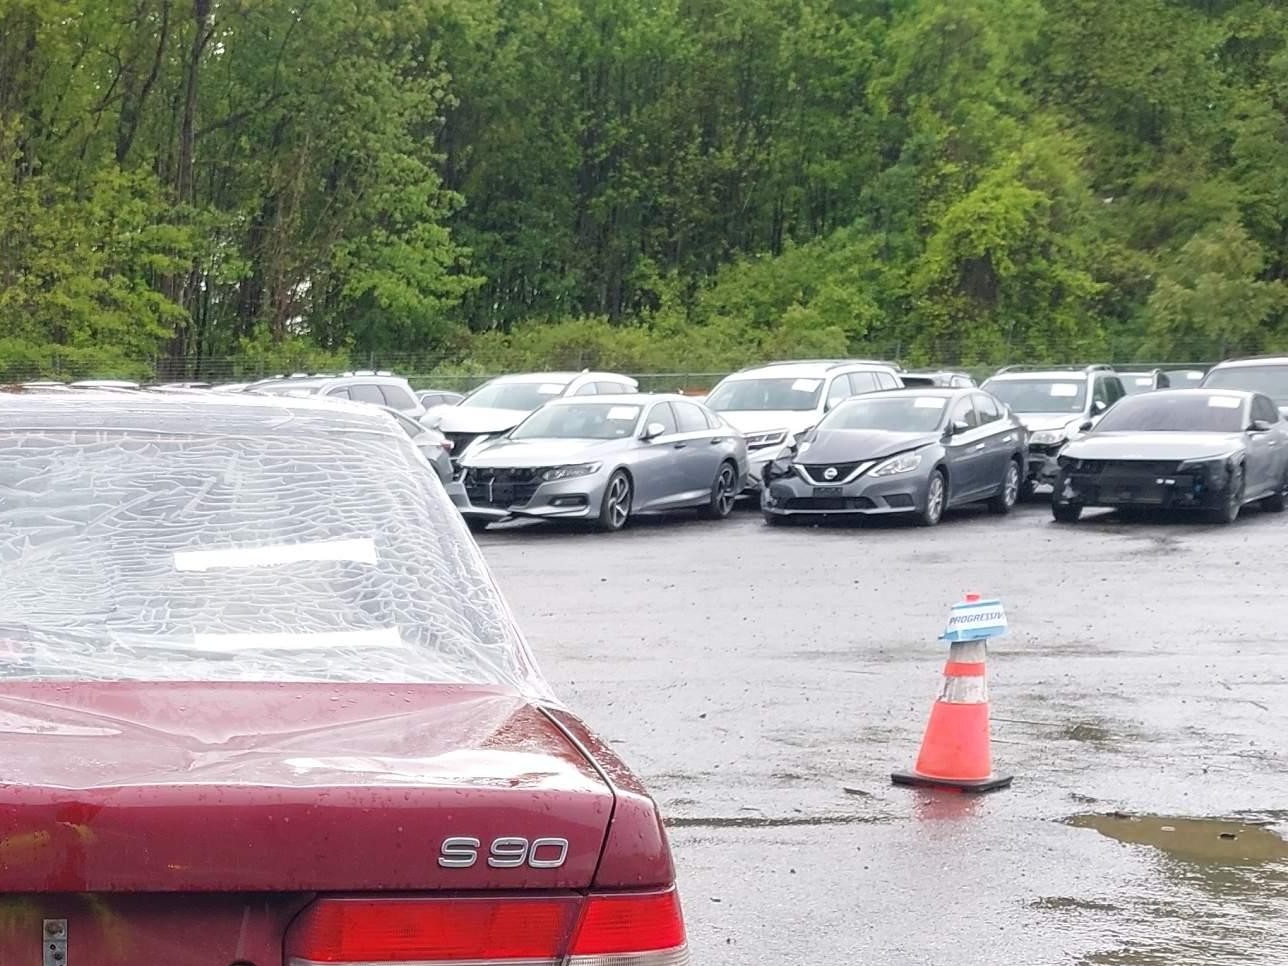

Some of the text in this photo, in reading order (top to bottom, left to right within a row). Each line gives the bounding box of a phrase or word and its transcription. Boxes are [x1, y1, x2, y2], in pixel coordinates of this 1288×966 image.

[948, 612, 1003, 625] PROGRESSIV
[438, 837, 569, 868] S 90
